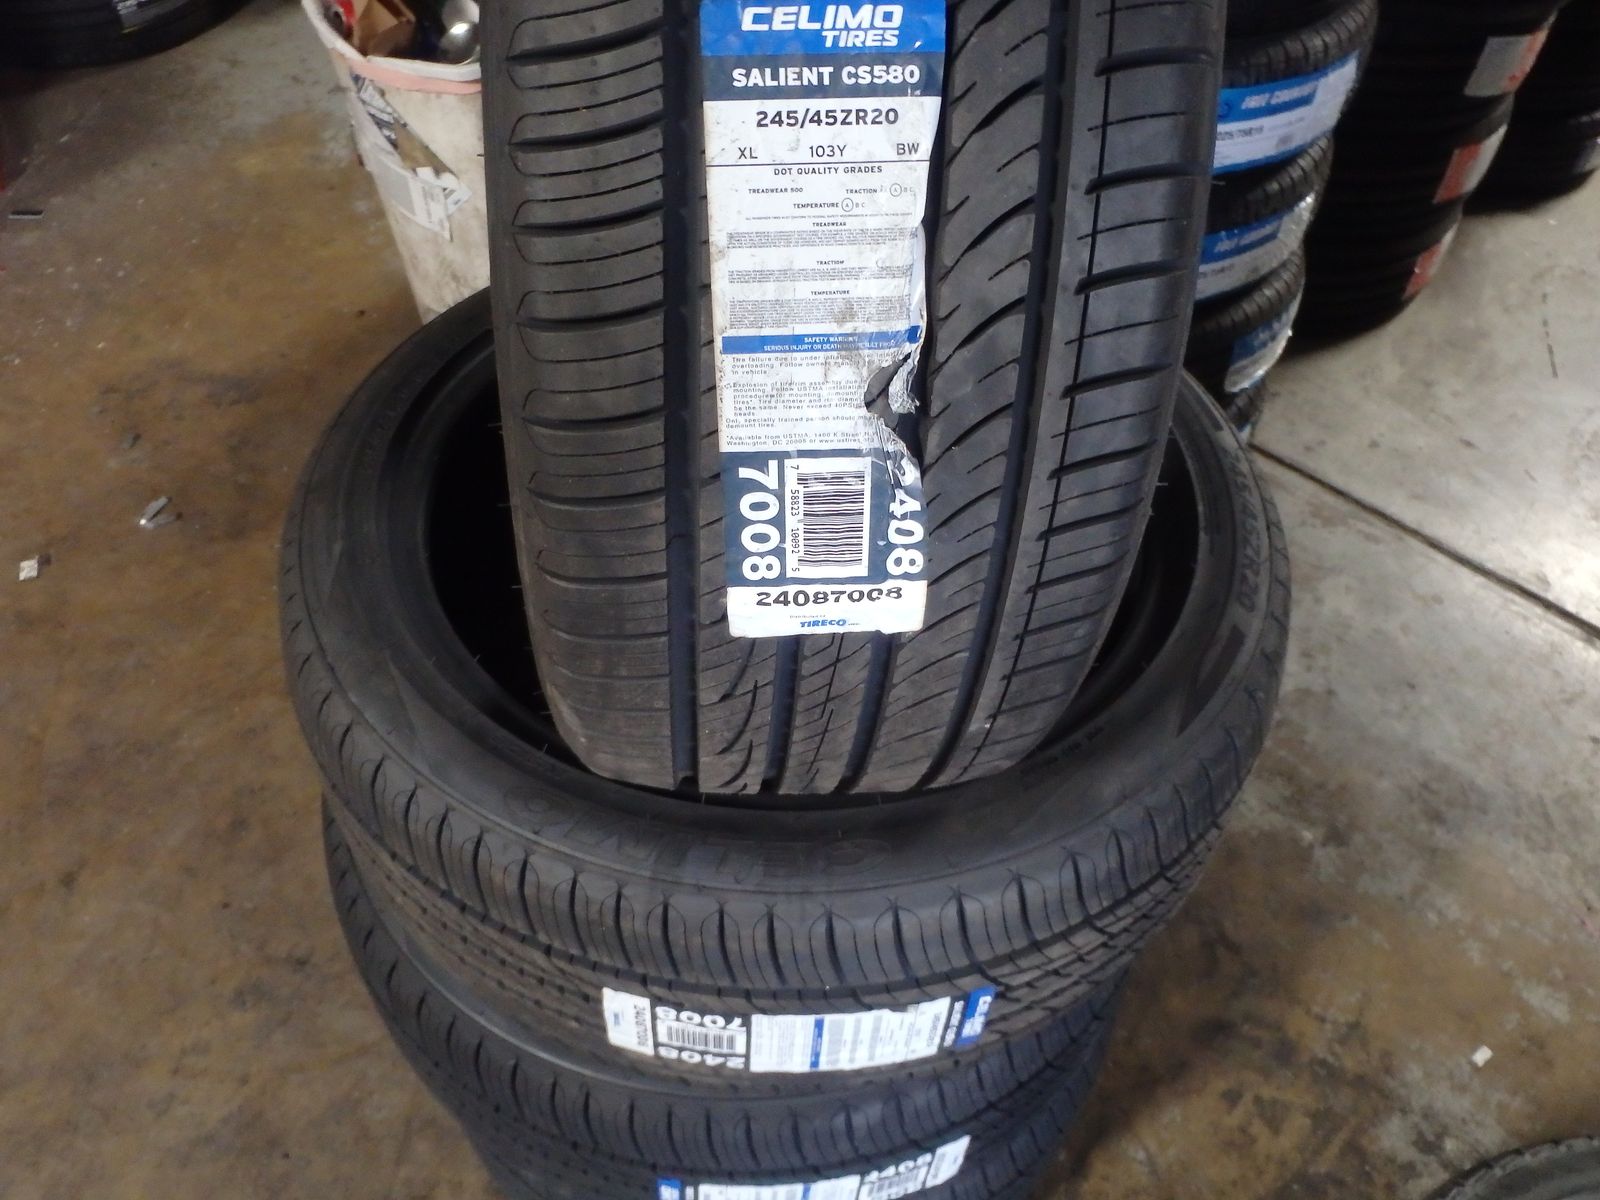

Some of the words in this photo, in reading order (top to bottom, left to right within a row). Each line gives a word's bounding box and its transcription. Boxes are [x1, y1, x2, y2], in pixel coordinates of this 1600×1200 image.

[741, 4, 904, 31] CELIMO
[822, 29, 899, 47] TIRES
[732, 67, 834, 87] SALIENT
[841, 65, 920, 84] CS580
[756, 108, 899, 129] 245/45ZR20
[738, 147, 758, 160] XL
[809, 145, 848, 158] 103Y
[896, 143, 920, 156] BW
[774, 168, 793, 176] DOT
[797, 166, 840, 175] QUALITY
[843, 165, 883, 174] GRADES
[790, 489, 800, 517] 58823
[739, 460, 781, 580] 7008
[886, 460, 924, 576] 2408
[791, 527, 801, 554] 10092
[756, 587, 903, 608] 24087008
[800, 619, 846, 628] TIRECO
[655, 1006, 747, 1033] 7008
